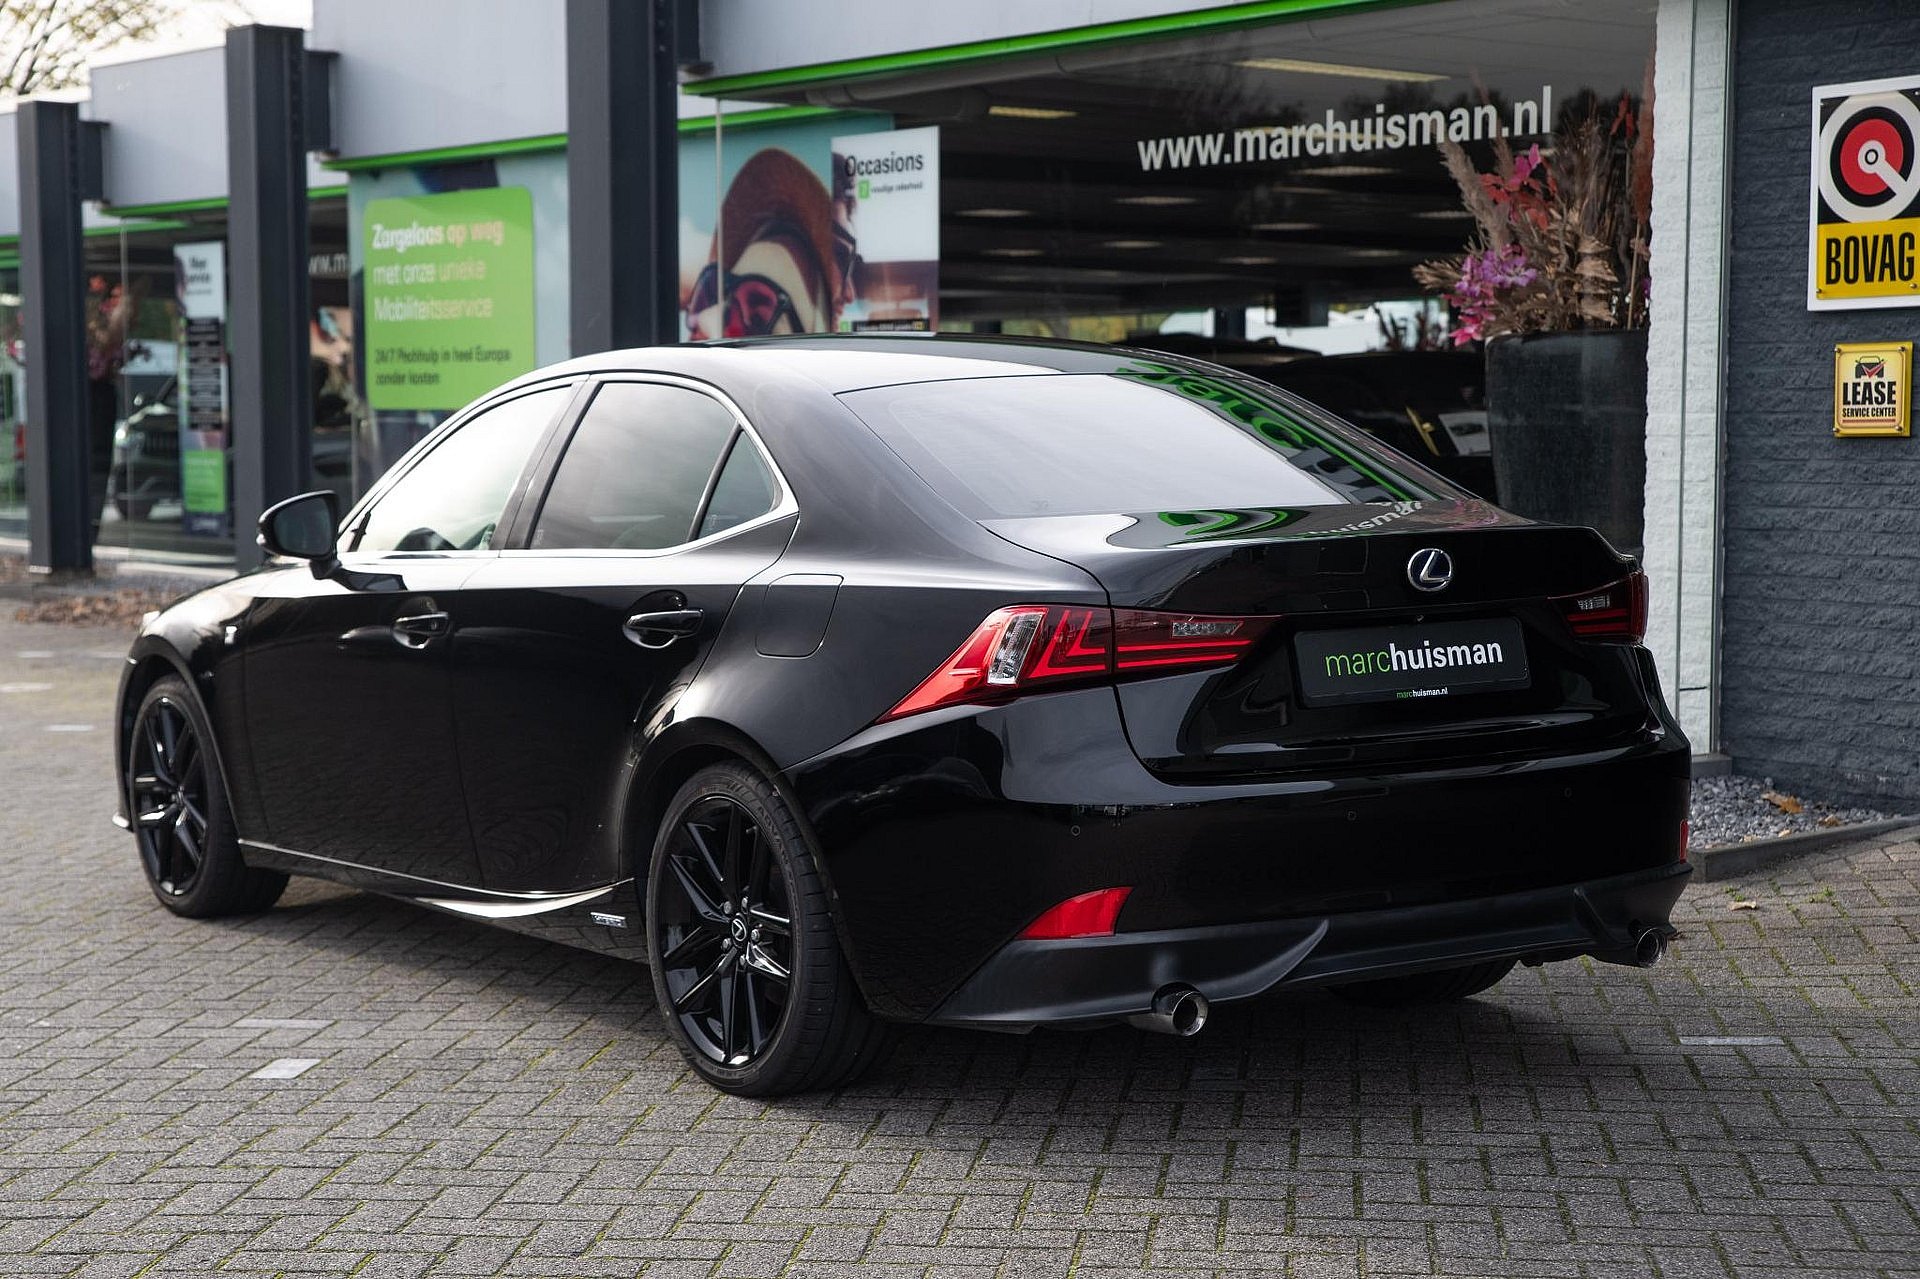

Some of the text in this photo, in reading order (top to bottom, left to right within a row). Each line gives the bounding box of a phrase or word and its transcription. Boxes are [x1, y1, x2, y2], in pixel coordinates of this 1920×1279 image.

[1137, 85, 1552, 171] www.marchuisman.nl
[844, 151, 923, 177] Occasions
[372, 221, 444, 253] Zorgeloos
[1825, 231, 1915, 285] BOVAG
[1842, 381, 1897, 405] LEASE
[1842, 407, 1897, 417] SERVICE CENTER
[1325, 640, 1503, 677] marchuisman
[1396, 687, 1449, 699] marchuisman.nl
